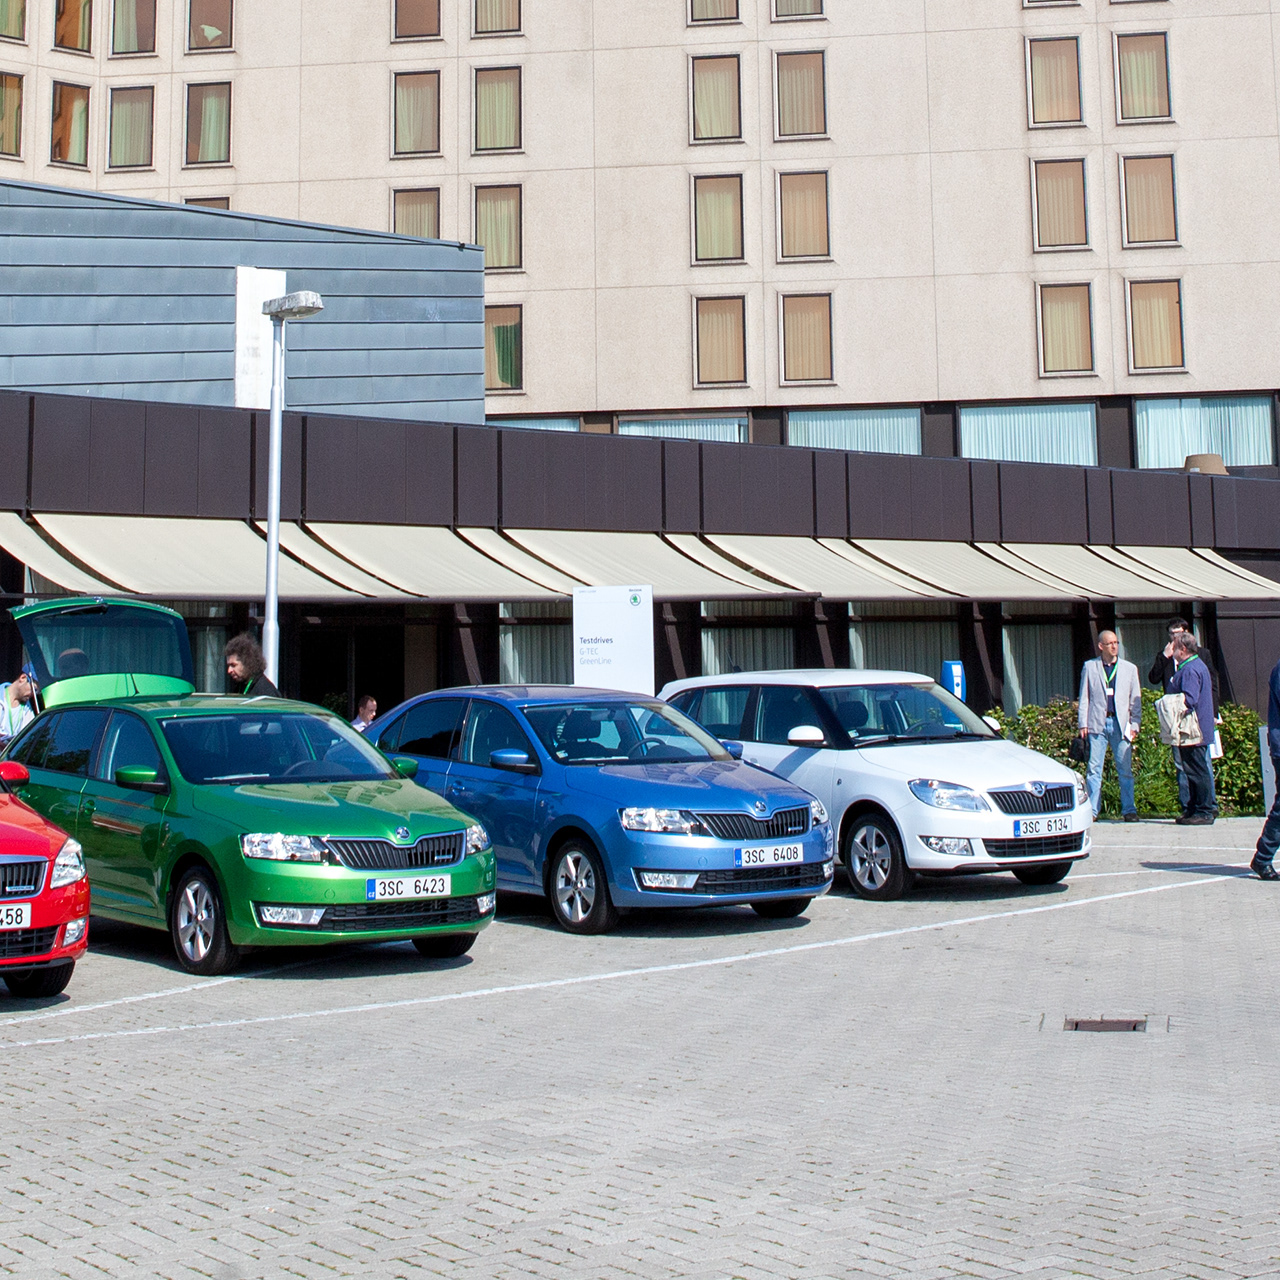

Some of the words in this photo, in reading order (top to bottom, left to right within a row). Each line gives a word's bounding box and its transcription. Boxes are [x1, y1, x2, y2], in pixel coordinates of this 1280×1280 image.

[579, 657, 612, 665] GreenLine
[1022, 821, 1040, 834] 3SC
[1047, 818, 1068, 832] 6134
[744, 849, 765, 864] 3SC
[773, 846, 798, 862] 6408
[379, 880, 404, 896] 3SC
[414, 878, 445, 894] 6423
